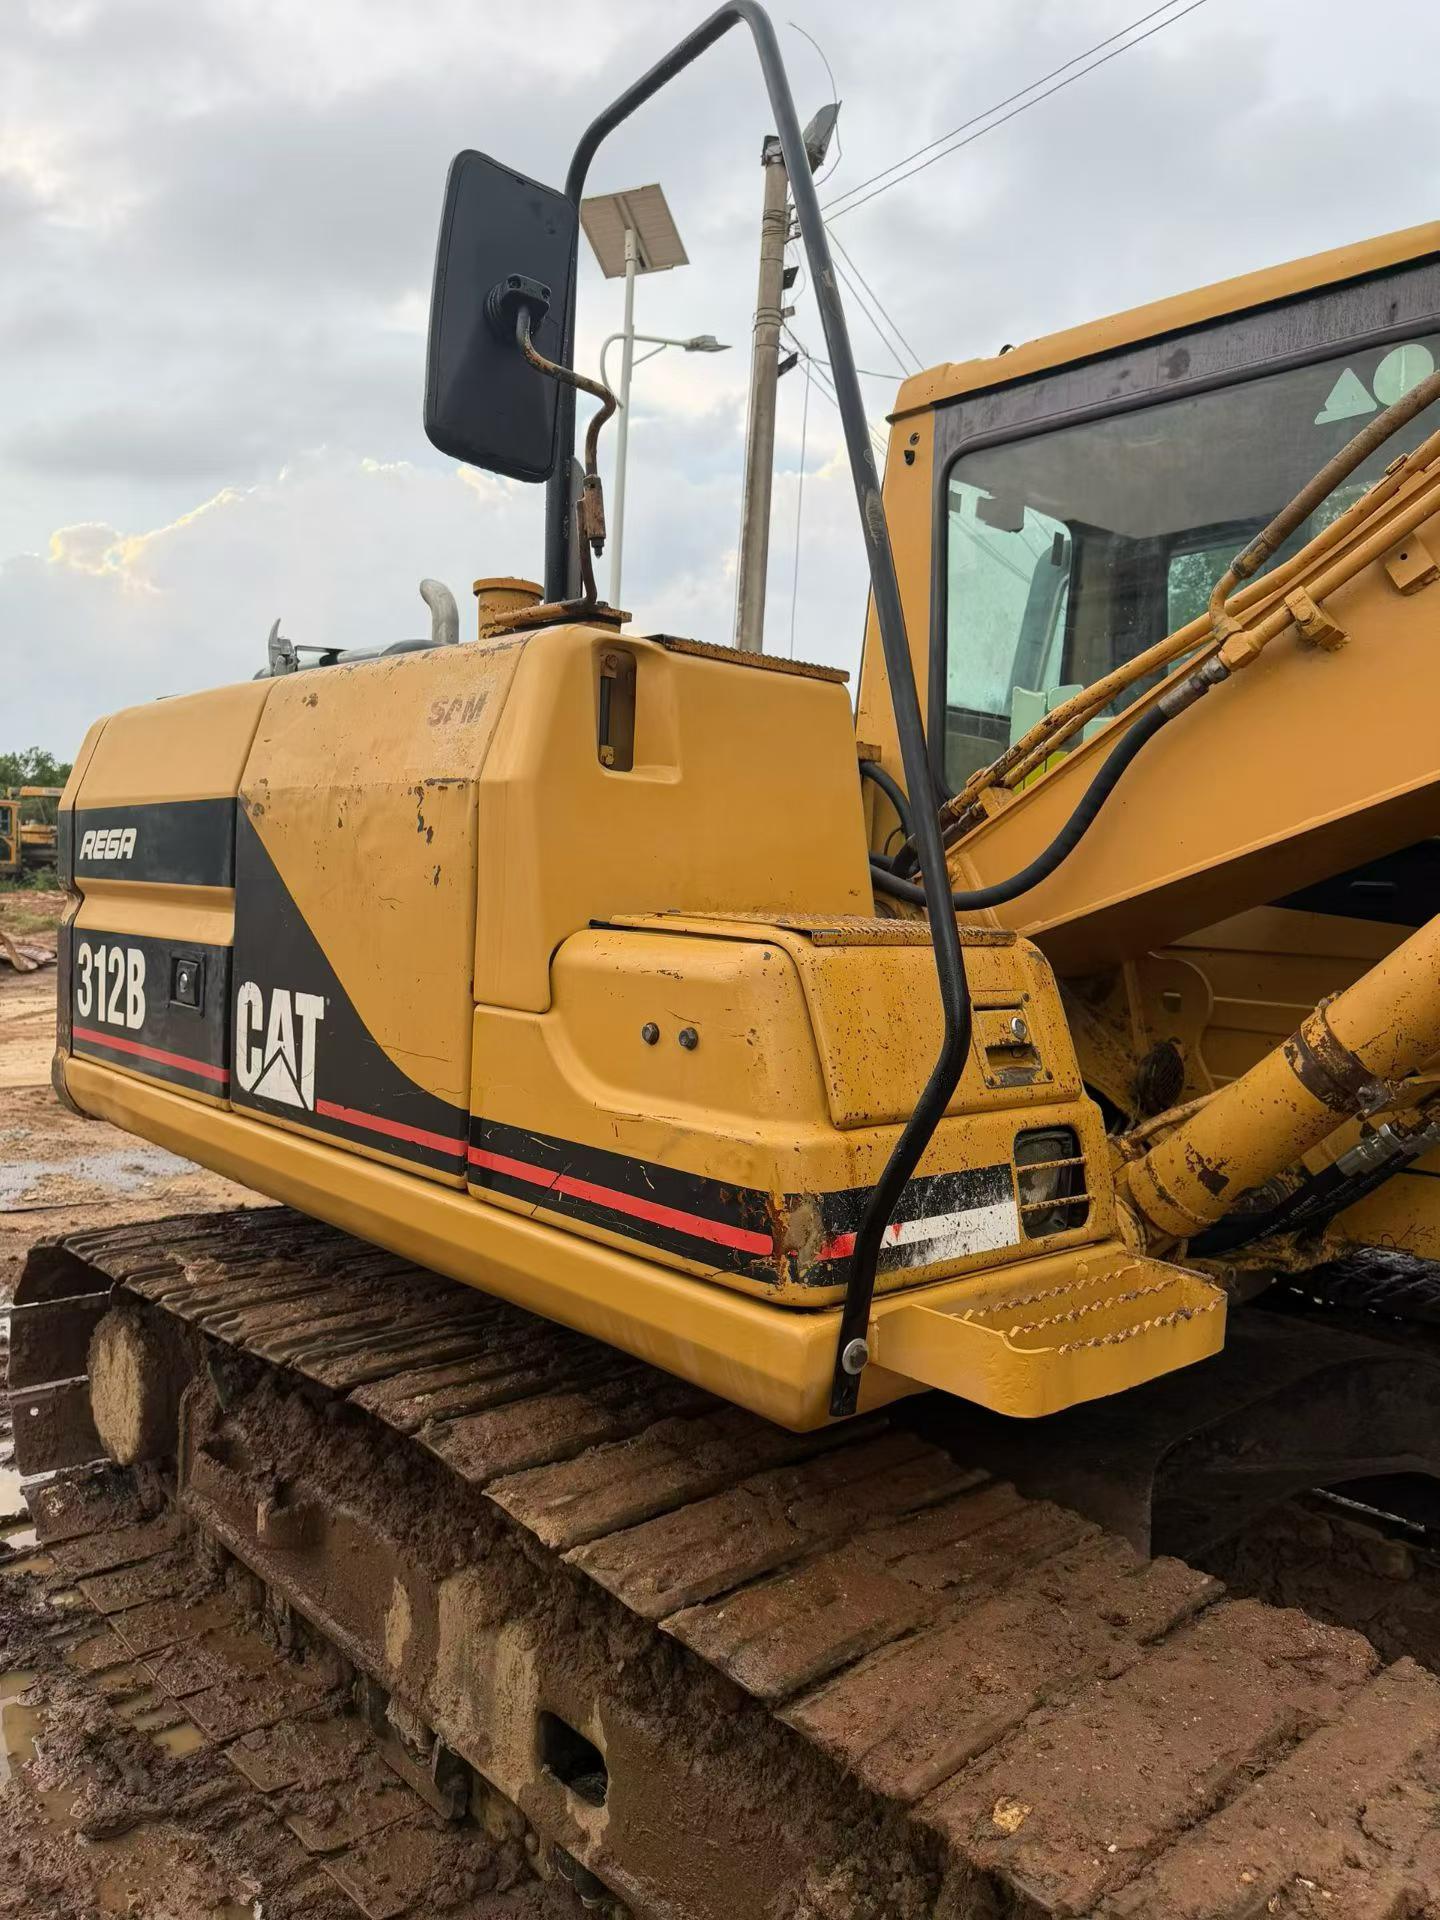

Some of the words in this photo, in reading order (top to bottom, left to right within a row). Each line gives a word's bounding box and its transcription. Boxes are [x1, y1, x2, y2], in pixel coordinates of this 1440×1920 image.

[80, 828, 137, 860] REGA
[78, 943, 146, 1029] 312B
[237, 981, 324, 1110] CAT
